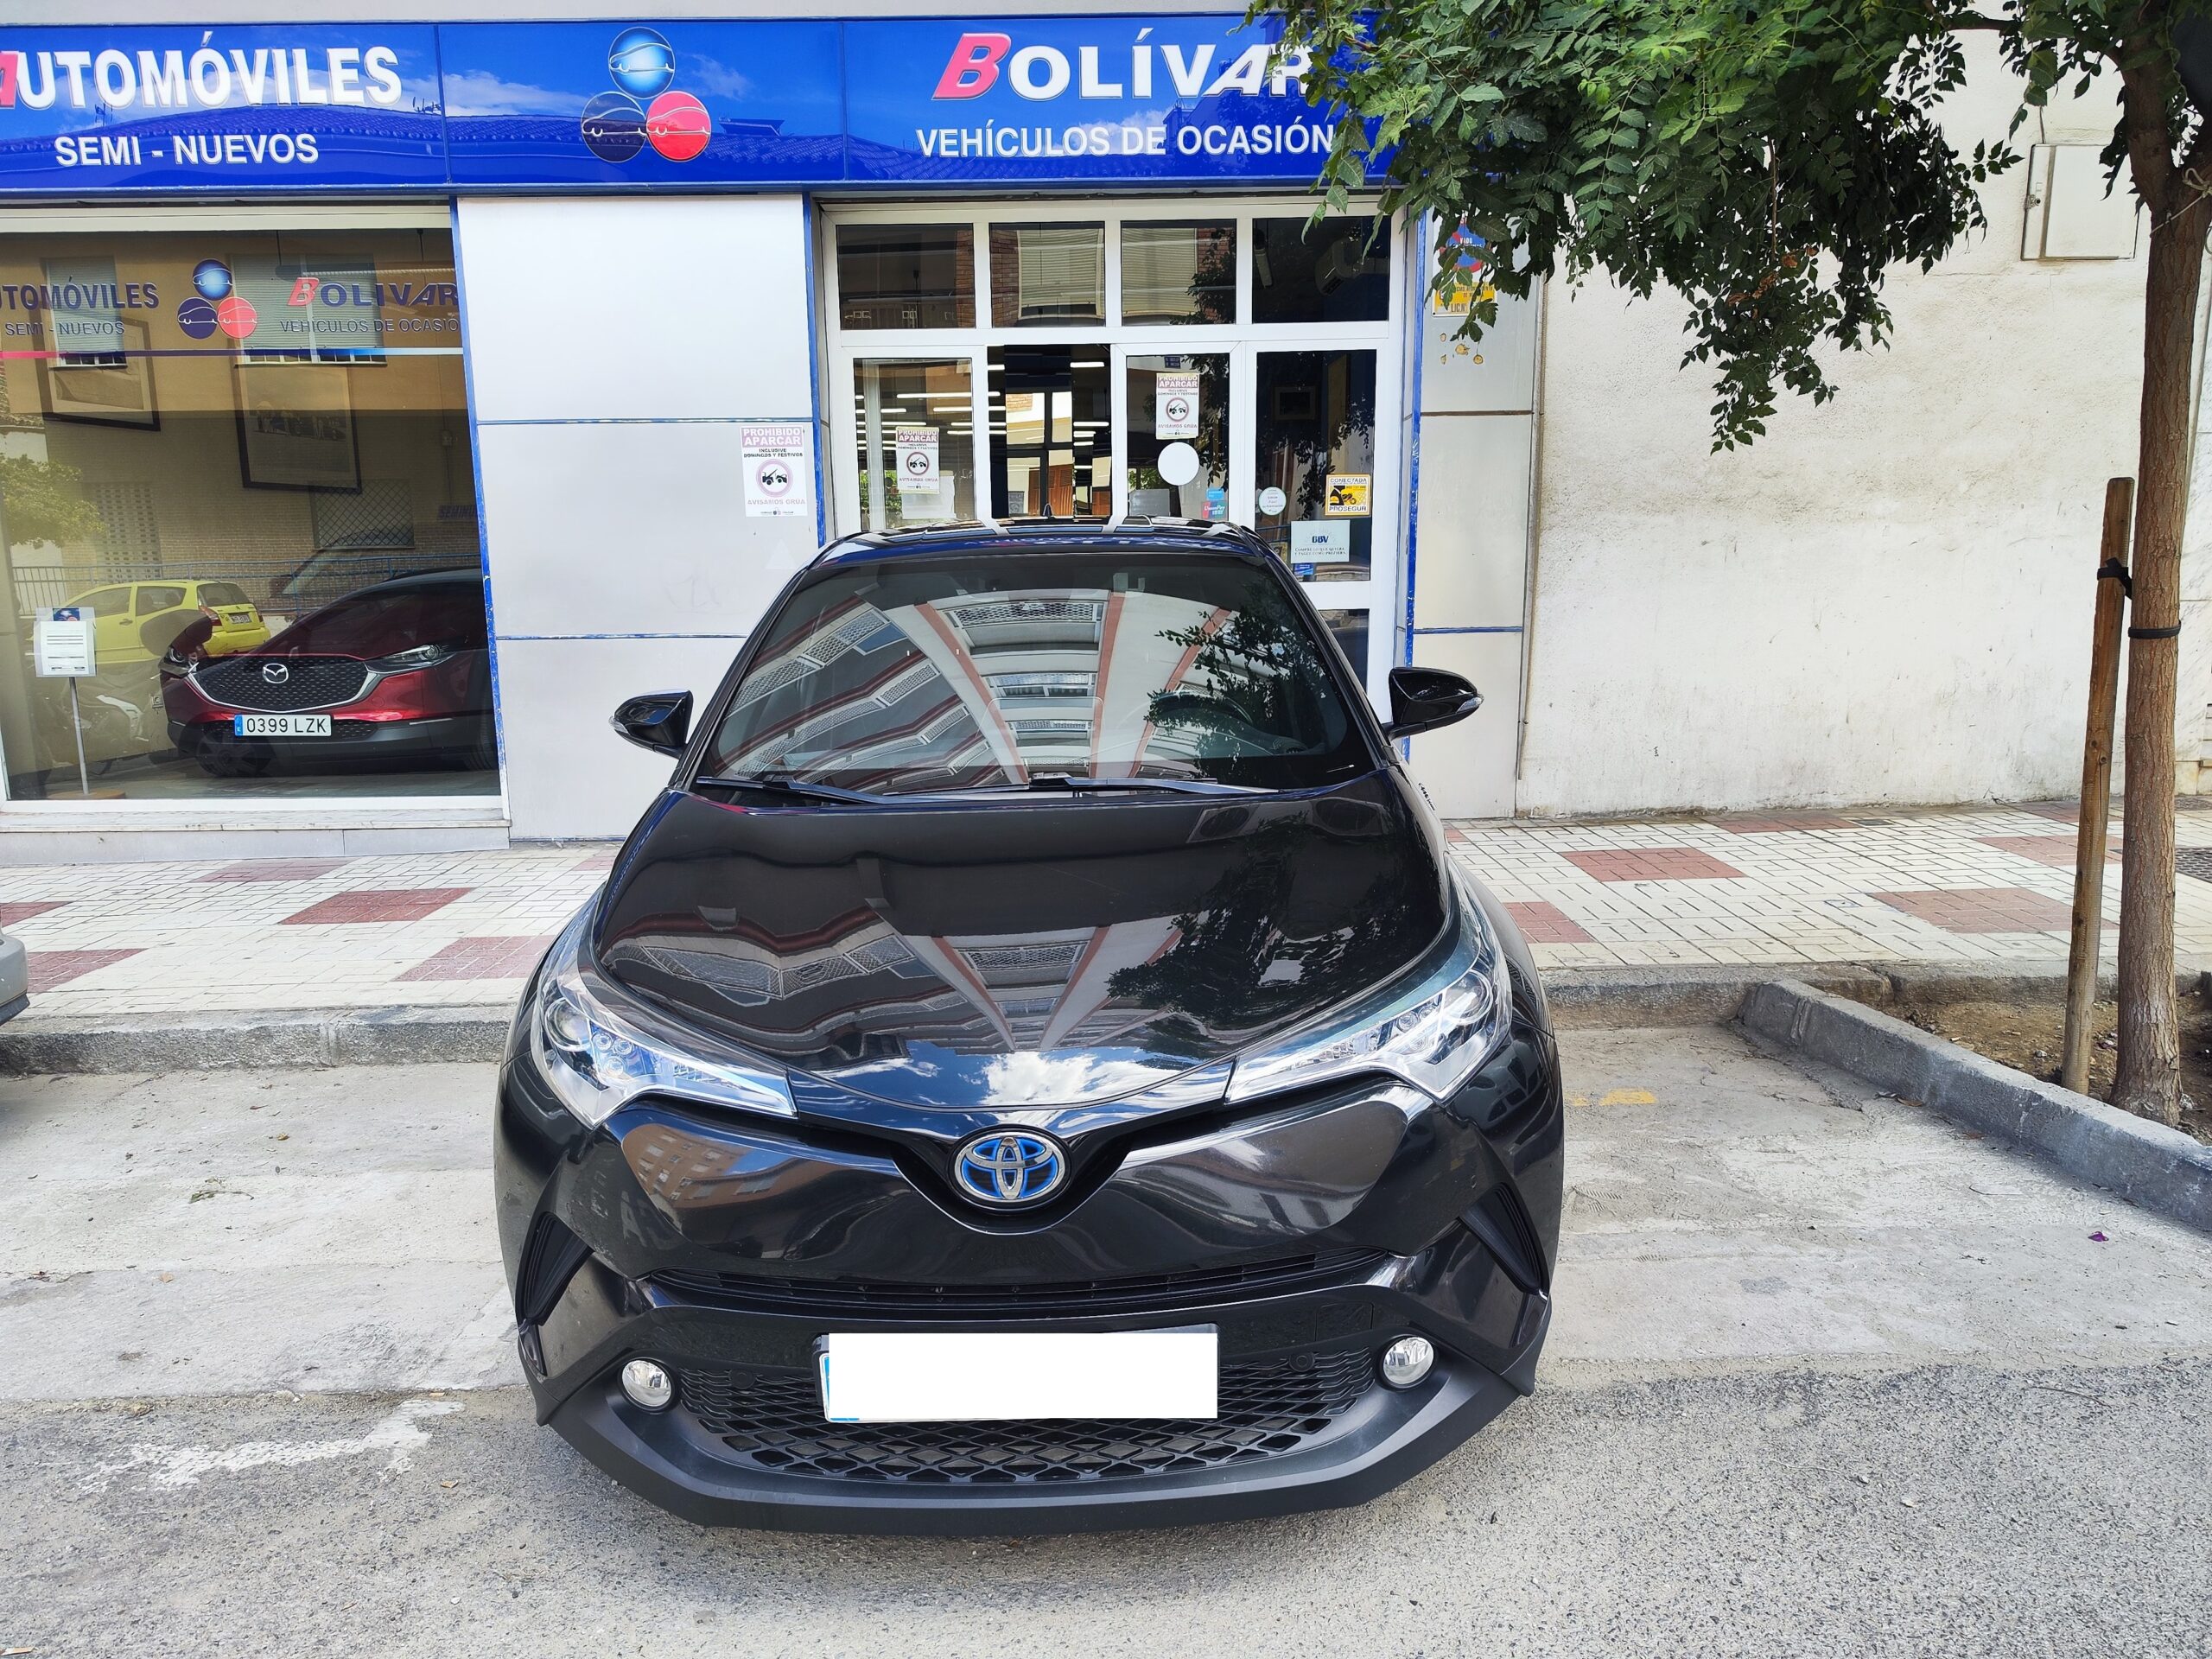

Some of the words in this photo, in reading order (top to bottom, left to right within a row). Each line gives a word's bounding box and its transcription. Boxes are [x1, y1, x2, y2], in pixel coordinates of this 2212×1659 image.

[0, 30, 402, 110] UTOMÓVILES
[931, 28, 1313, 101] BOLÍVAR
[915, 118, 1110, 157] VEHÍCULOS
[1122, 126, 1166, 156] DE
[1177, 115, 1334, 156] OCASIÓN
[54, 136, 142, 166] SEMI
[173, 133, 319, 165] NUEVOS
[0, 275, 160, 310] TOMÓVILES
[5, 323, 44, 335] SEMI
[59, 321, 125, 334] NUEVOS
[374, 318, 394, 332] DE
[398, 317, 460, 332] OCASIO
[743, 428, 801, 436] PROHIBIDO
[744, 435, 801, 446] APARCAR
[246, 718, 288, 733] 0399
[294, 718, 327, 733] LZK
